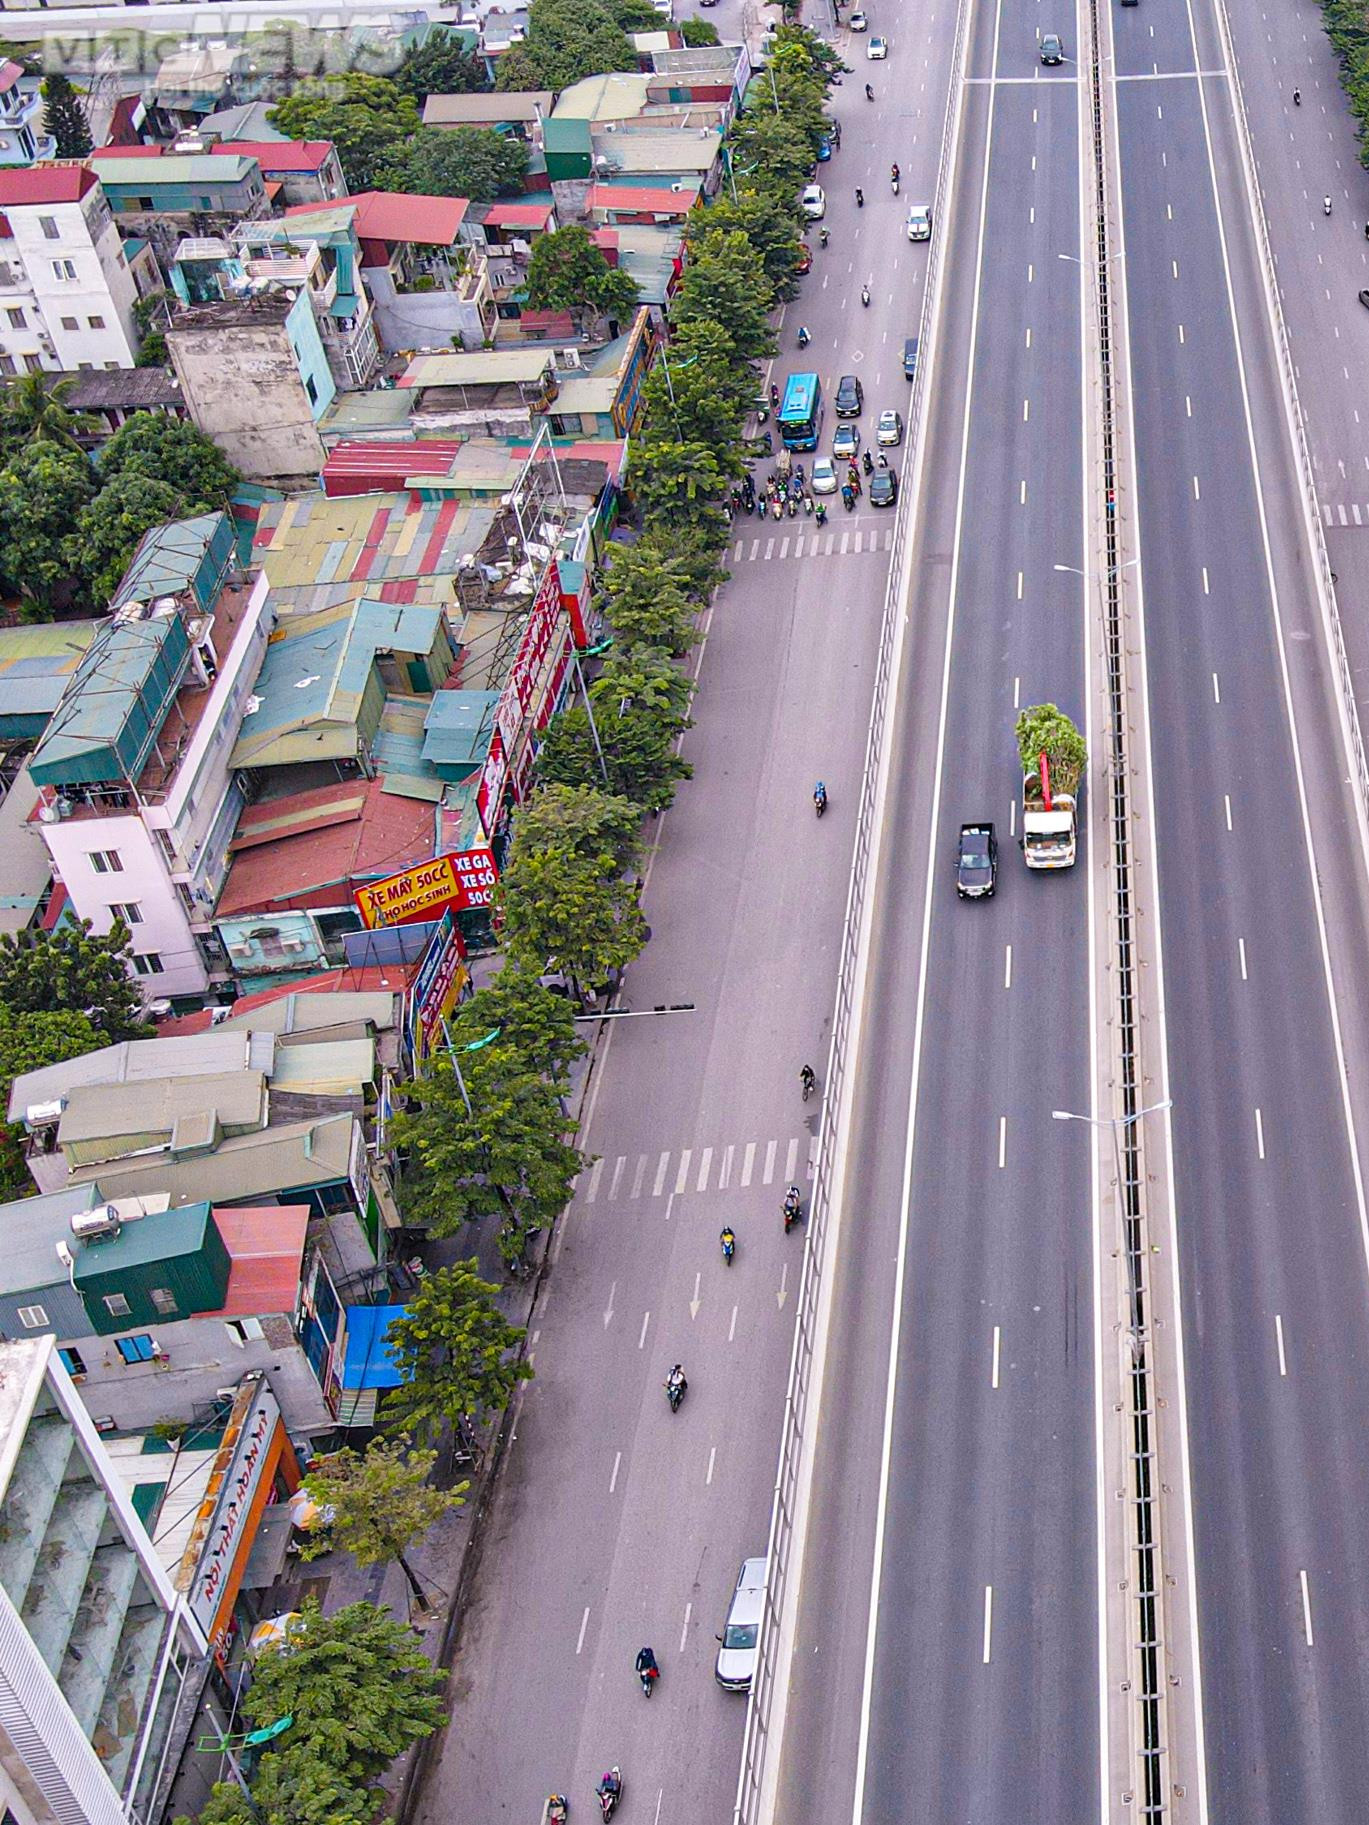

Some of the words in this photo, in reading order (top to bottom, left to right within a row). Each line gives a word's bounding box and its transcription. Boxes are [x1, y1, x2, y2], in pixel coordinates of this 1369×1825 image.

[454, 857, 472, 871] XE
[472, 854, 491, 869] GA
[367, 890, 386, 909] XE
[416, 863, 448, 888] 50CC
[460, 873, 478, 888] XE
[478, 867, 495, 886] SỐ
[425, 885, 451, 902] SINH
[468, 889, 494, 905] 50C
